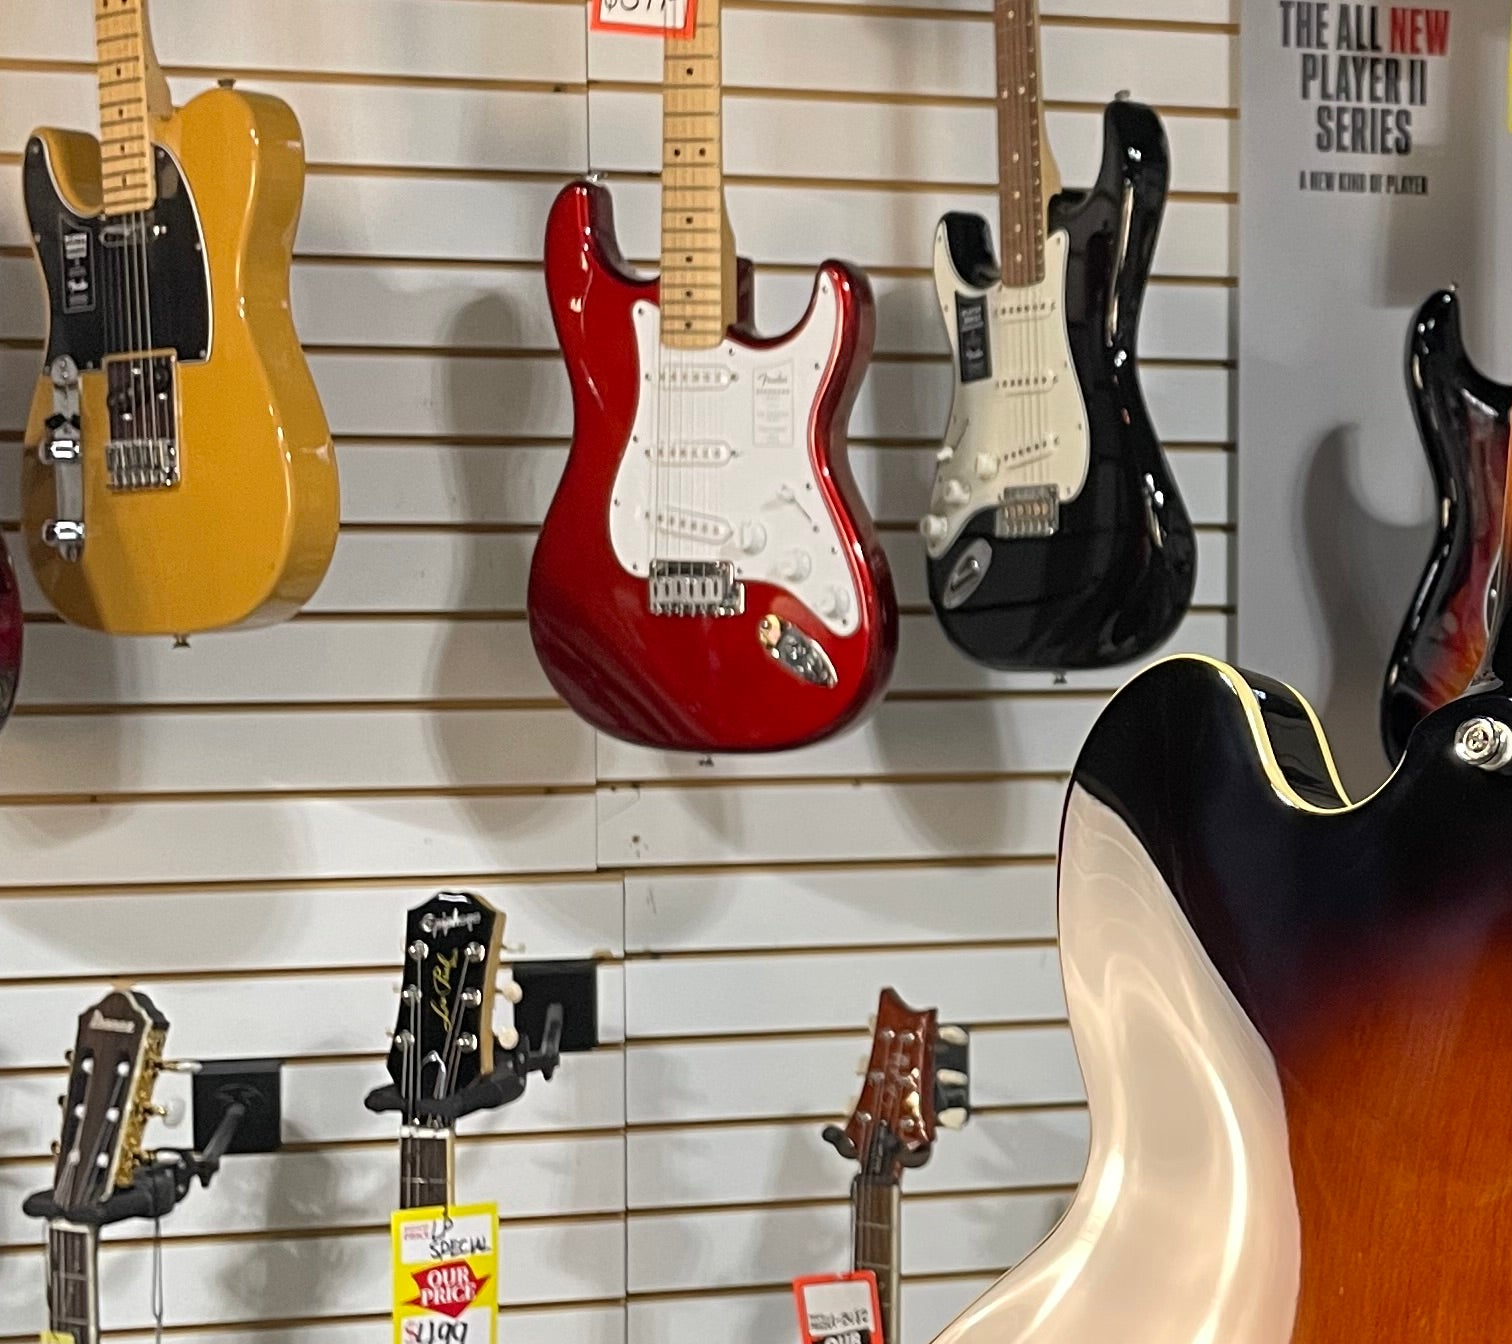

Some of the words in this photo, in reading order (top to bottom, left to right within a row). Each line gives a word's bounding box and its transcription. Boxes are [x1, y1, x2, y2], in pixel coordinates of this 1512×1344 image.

[1280, 0, 1329, 48] THE
[1336, 3, 1382, 53] ALL
[1389, 6, 1450, 56] NEW
[1301, 54, 1402, 104] PLAYER
[1410, 59, 1428, 106] II
[1315, 105, 1413, 156] SERIES
[1299, 170, 1307, 190] A
[1310, 171, 1336, 191] NEW
[1339, 172, 1366, 192] KIND
[1370, 173, 1383, 193] OF
[1386, 174, 1429, 196] PLAYER
[421, 1283, 476, 1307] PRICE
[427, 1266, 470, 1287] OUR
